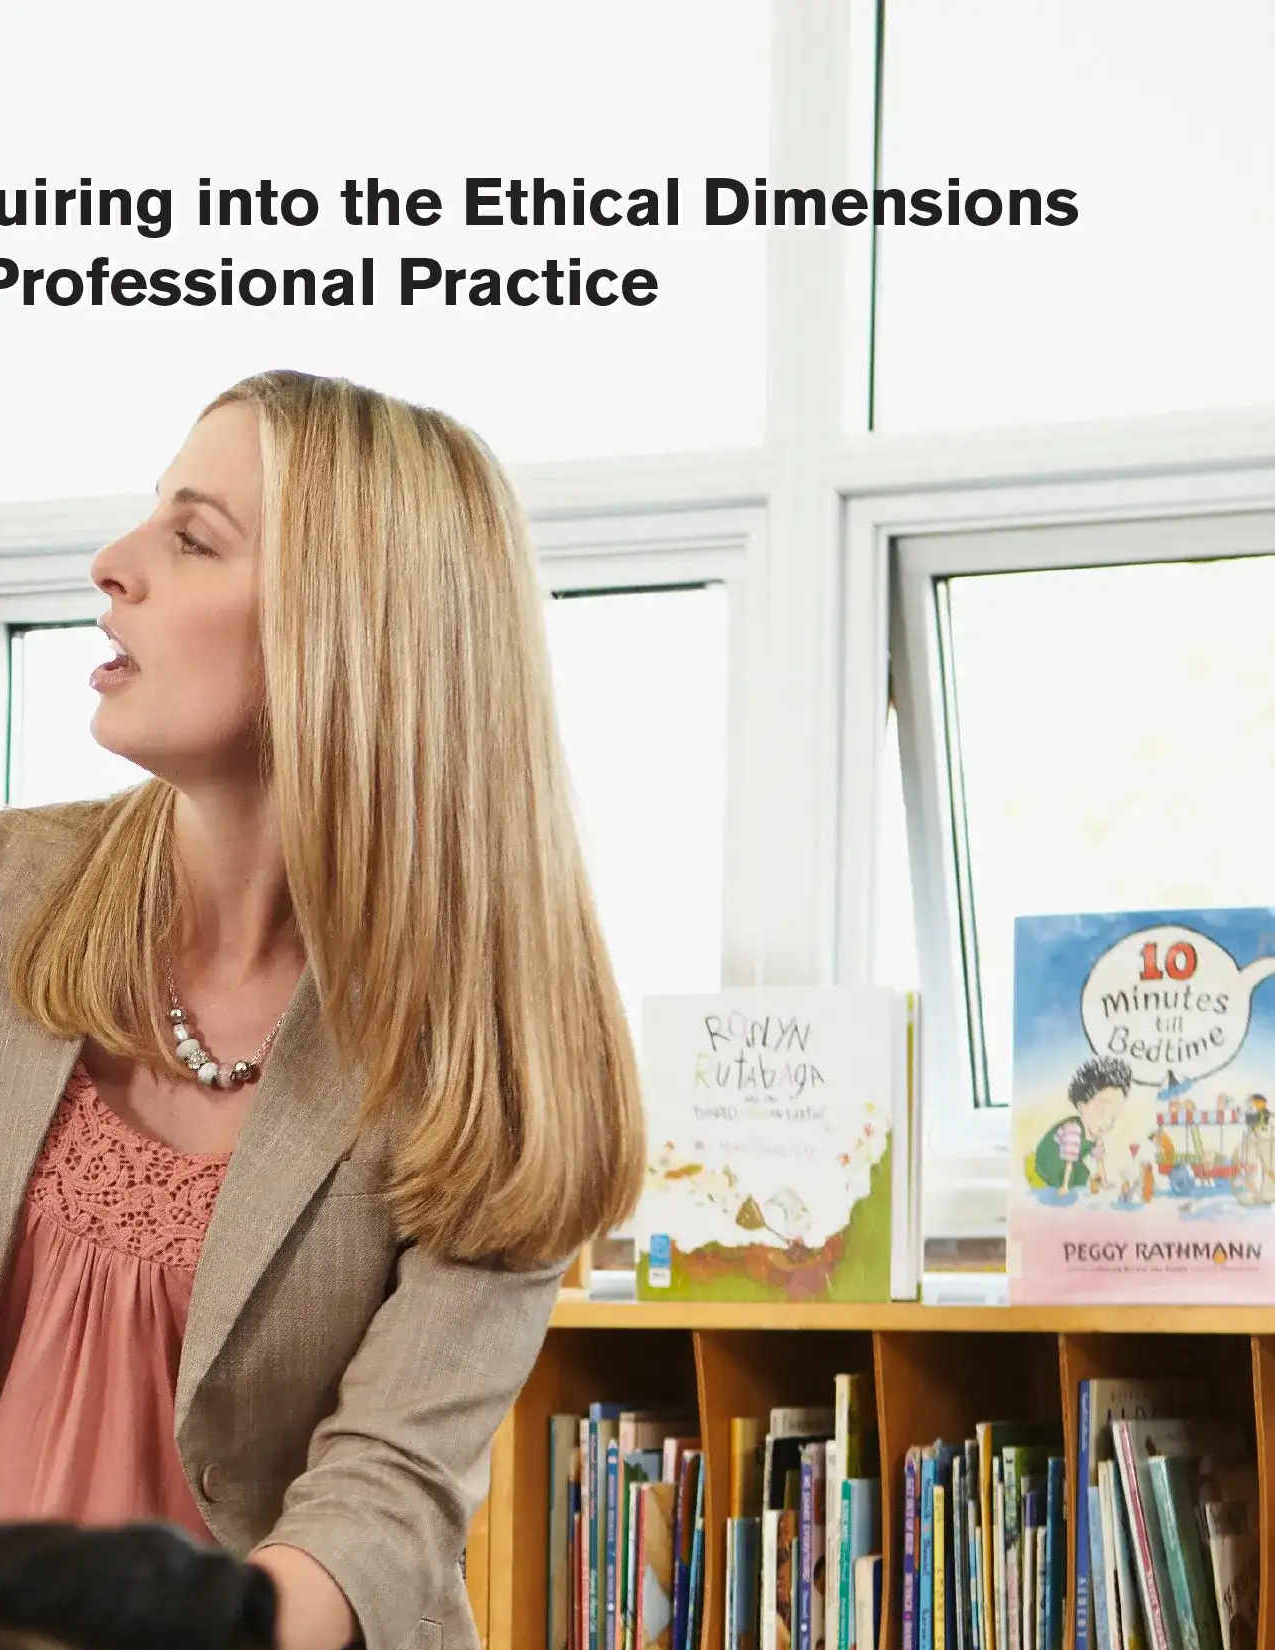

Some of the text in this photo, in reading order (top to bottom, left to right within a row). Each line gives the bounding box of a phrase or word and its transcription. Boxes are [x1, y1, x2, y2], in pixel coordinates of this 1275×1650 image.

[1139, 941, 1199, 981] 10
[1155, 1015, 1184, 1035] till
[1107, 1024, 1226, 1064] Bedtime
[1062, 1240, 1263, 1264] PEGGY RATHMANN
